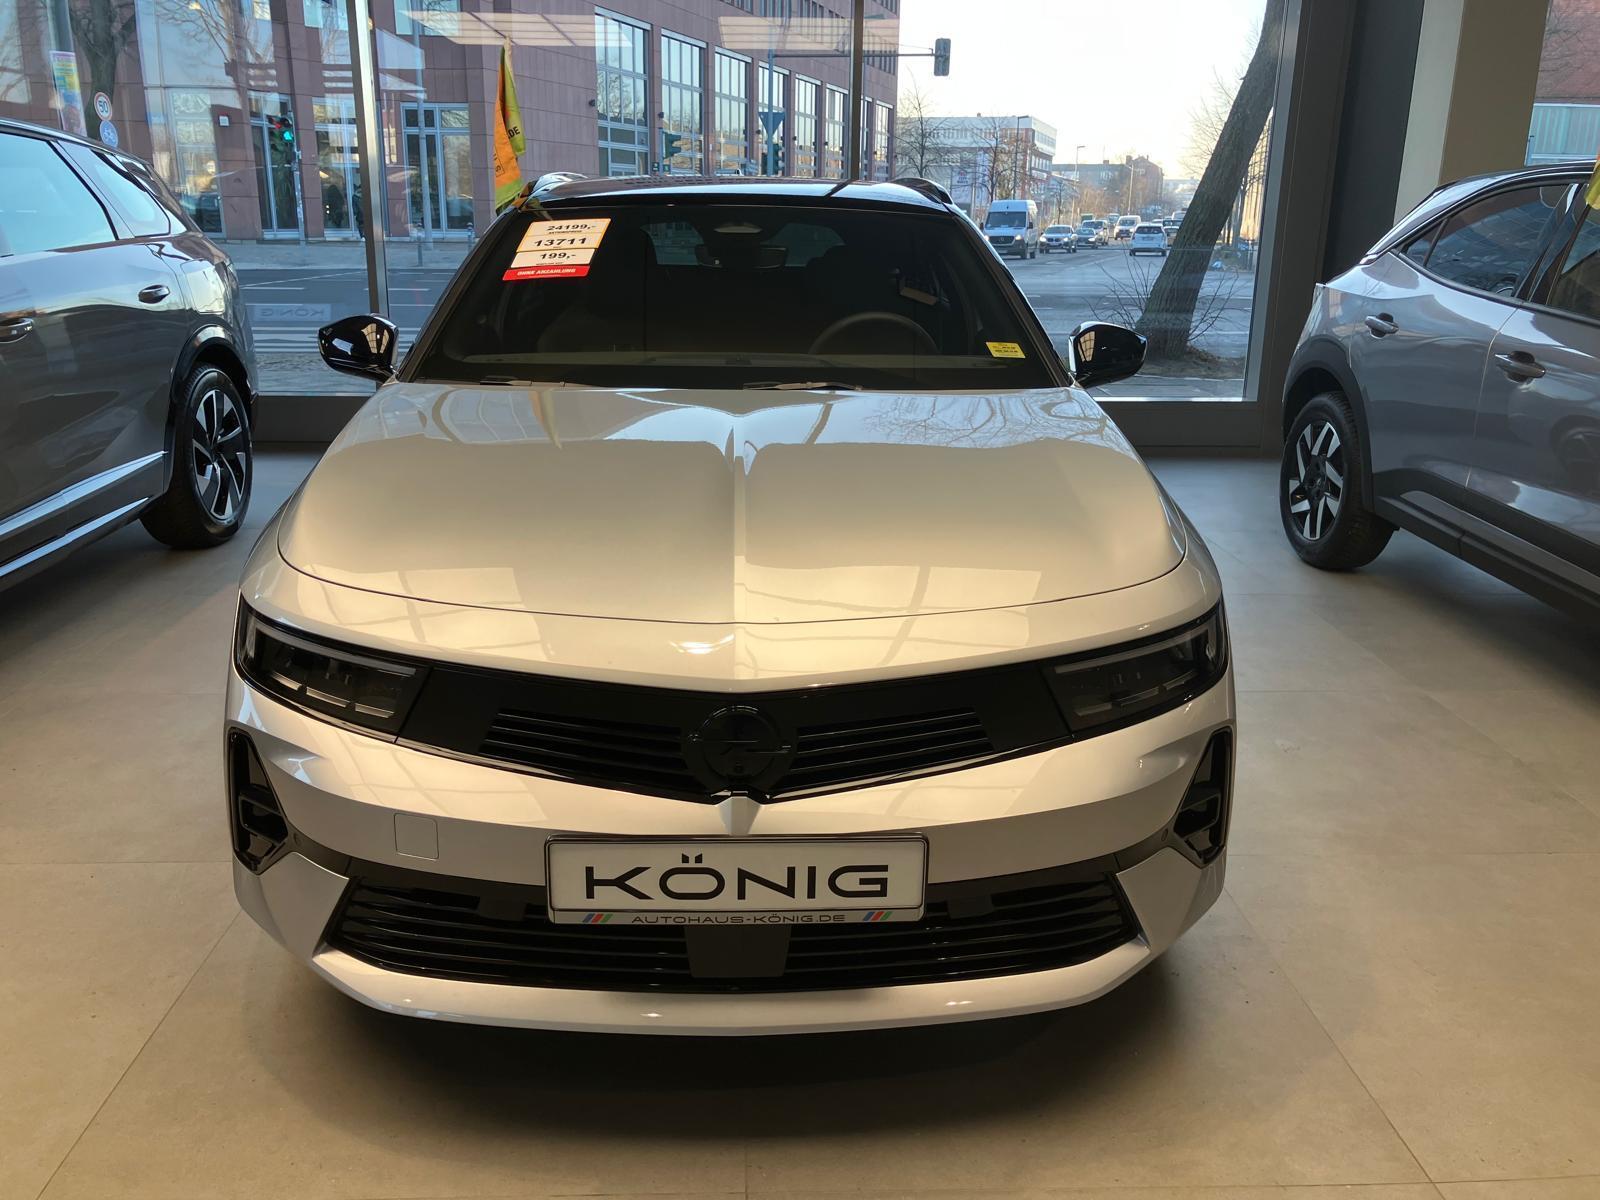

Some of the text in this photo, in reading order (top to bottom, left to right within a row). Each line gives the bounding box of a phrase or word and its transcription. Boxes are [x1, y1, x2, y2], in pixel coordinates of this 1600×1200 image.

[98, 100, 109, 113] 50
[547, 223, 597, 231] 24199,-
[534, 237, 587, 247] 13711
[540, 252, 576, 260] 199,-
[585, 853, 889, 900] KÖNIG
[631, 912, 846, 925] AUTOHAUS-KÖNIG.DE
